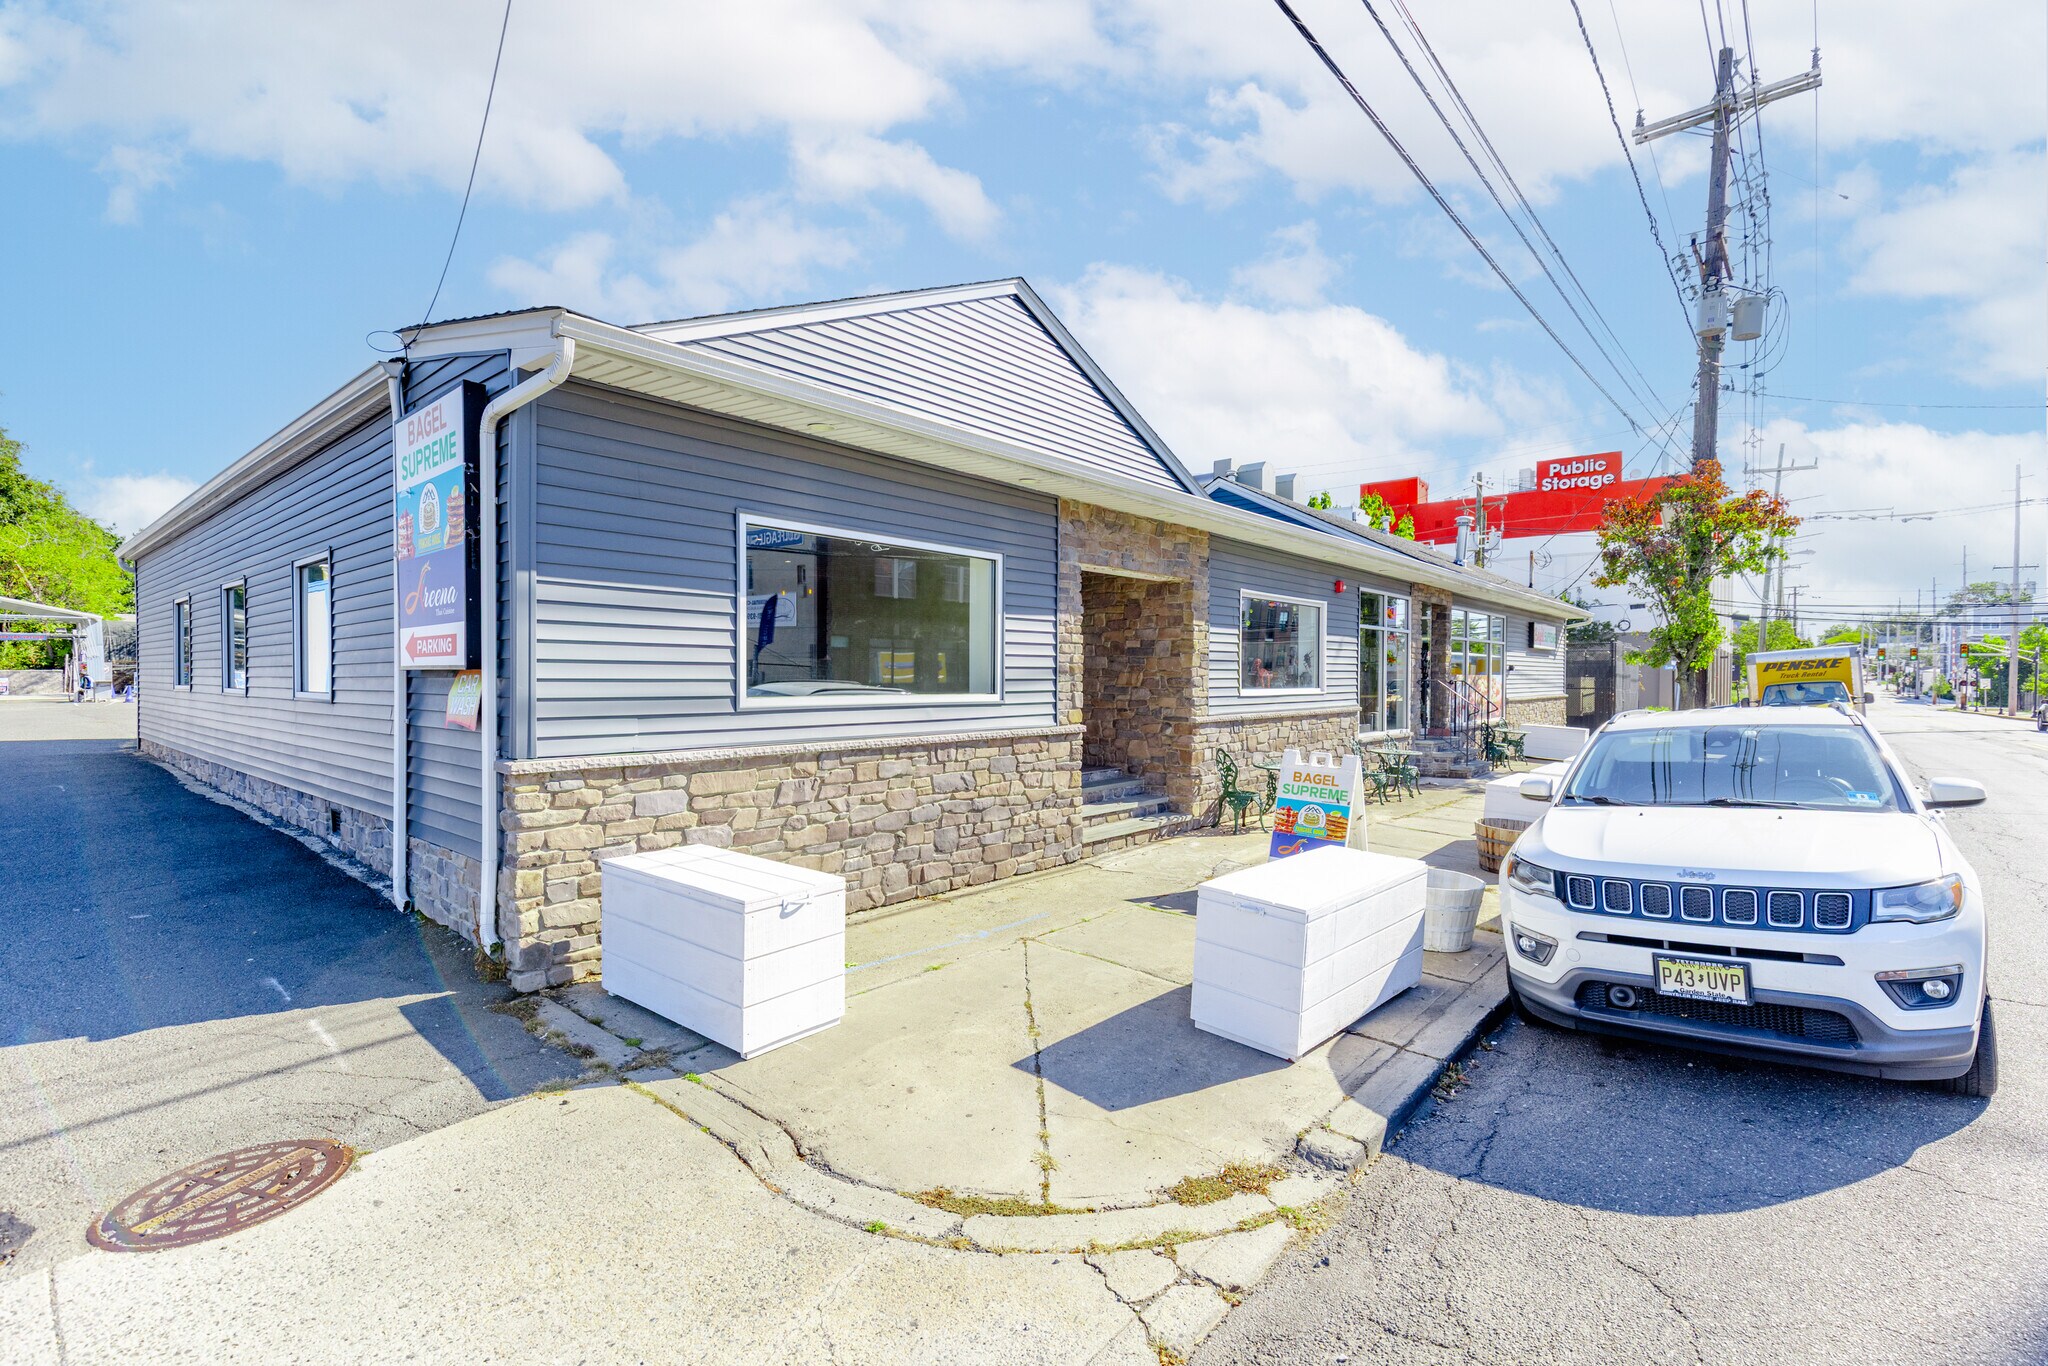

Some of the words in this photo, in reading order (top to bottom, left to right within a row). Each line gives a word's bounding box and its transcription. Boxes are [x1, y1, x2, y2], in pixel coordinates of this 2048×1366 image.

[408, 404, 447, 447] BAGEL
[401, 430, 456, 481] SUPREME
[1549, 458, 1607, 477] Public
[1541, 473, 1615, 491] Storage
[416, 637, 452, 654] PARKING
[1763, 658, 1843, 672] PENSKE
[1801, 670, 1827, 678] Rental
[457, 674, 480, 693] CAR
[449, 695, 478, 716] WASH
[1293, 771, 1339, 787] BAGEL
[1282, 783, 1349, 802] SUPREME
[1680, 987, 1705, 996] Garden
[1706, 990, 1726, 998] State
